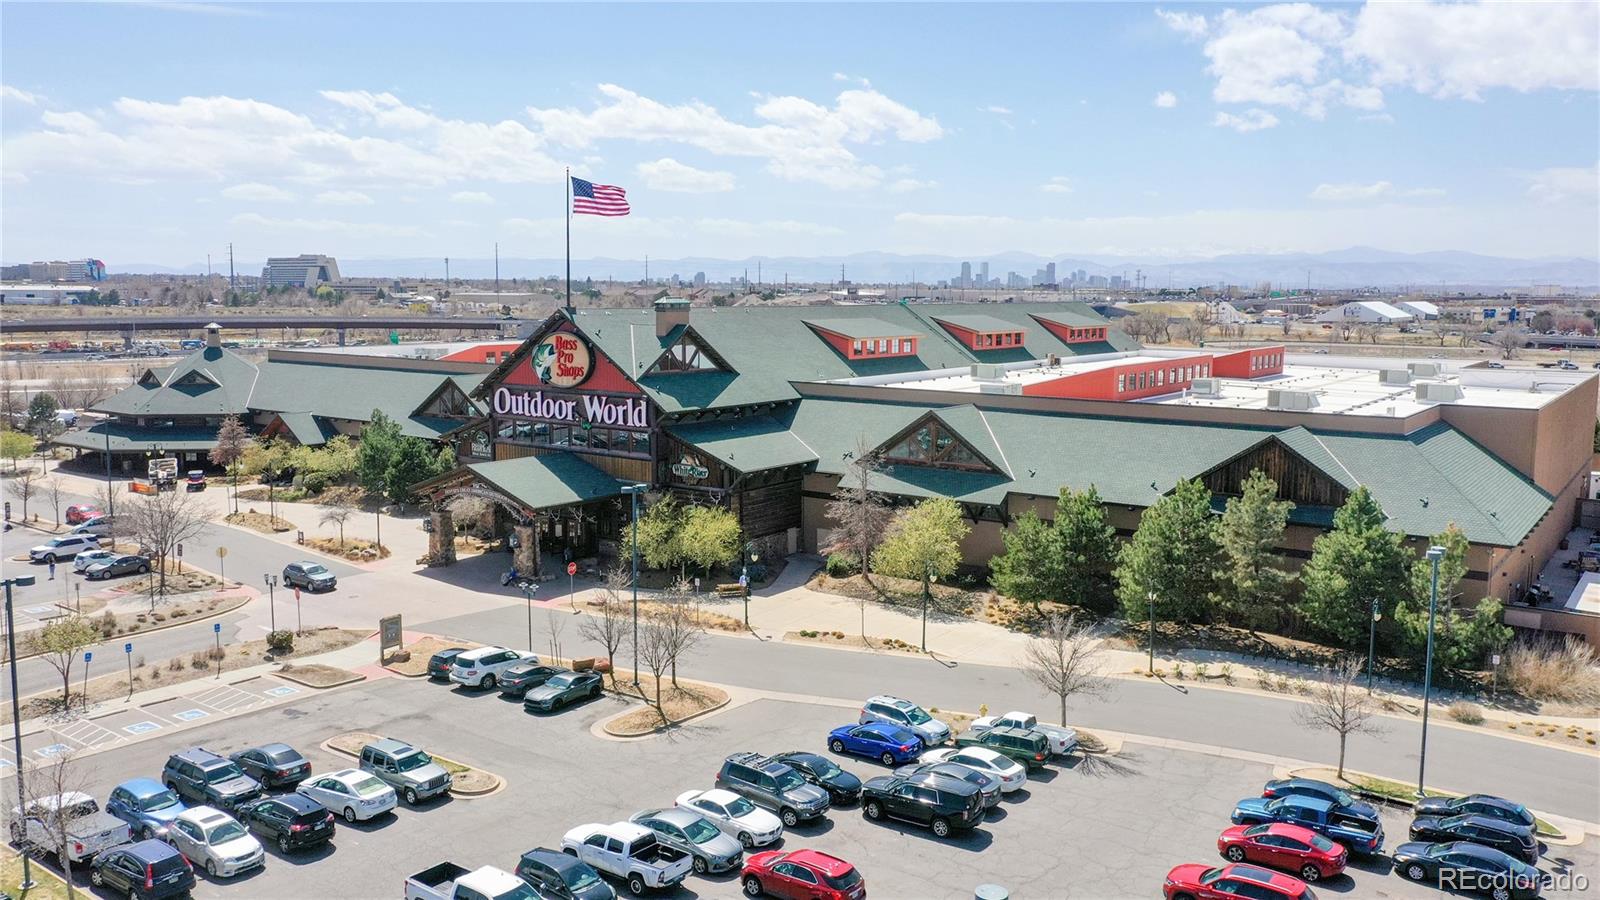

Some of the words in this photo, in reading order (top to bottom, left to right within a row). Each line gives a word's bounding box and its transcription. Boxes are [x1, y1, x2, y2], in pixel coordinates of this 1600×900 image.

[555, 335, 578, 350] Bass
[557, 350, 574, 363] Pro
[556, 364, 585, 380] Shops
[494, 387, 577, 421] Outdoor
[582, 395, 648, 427] World
